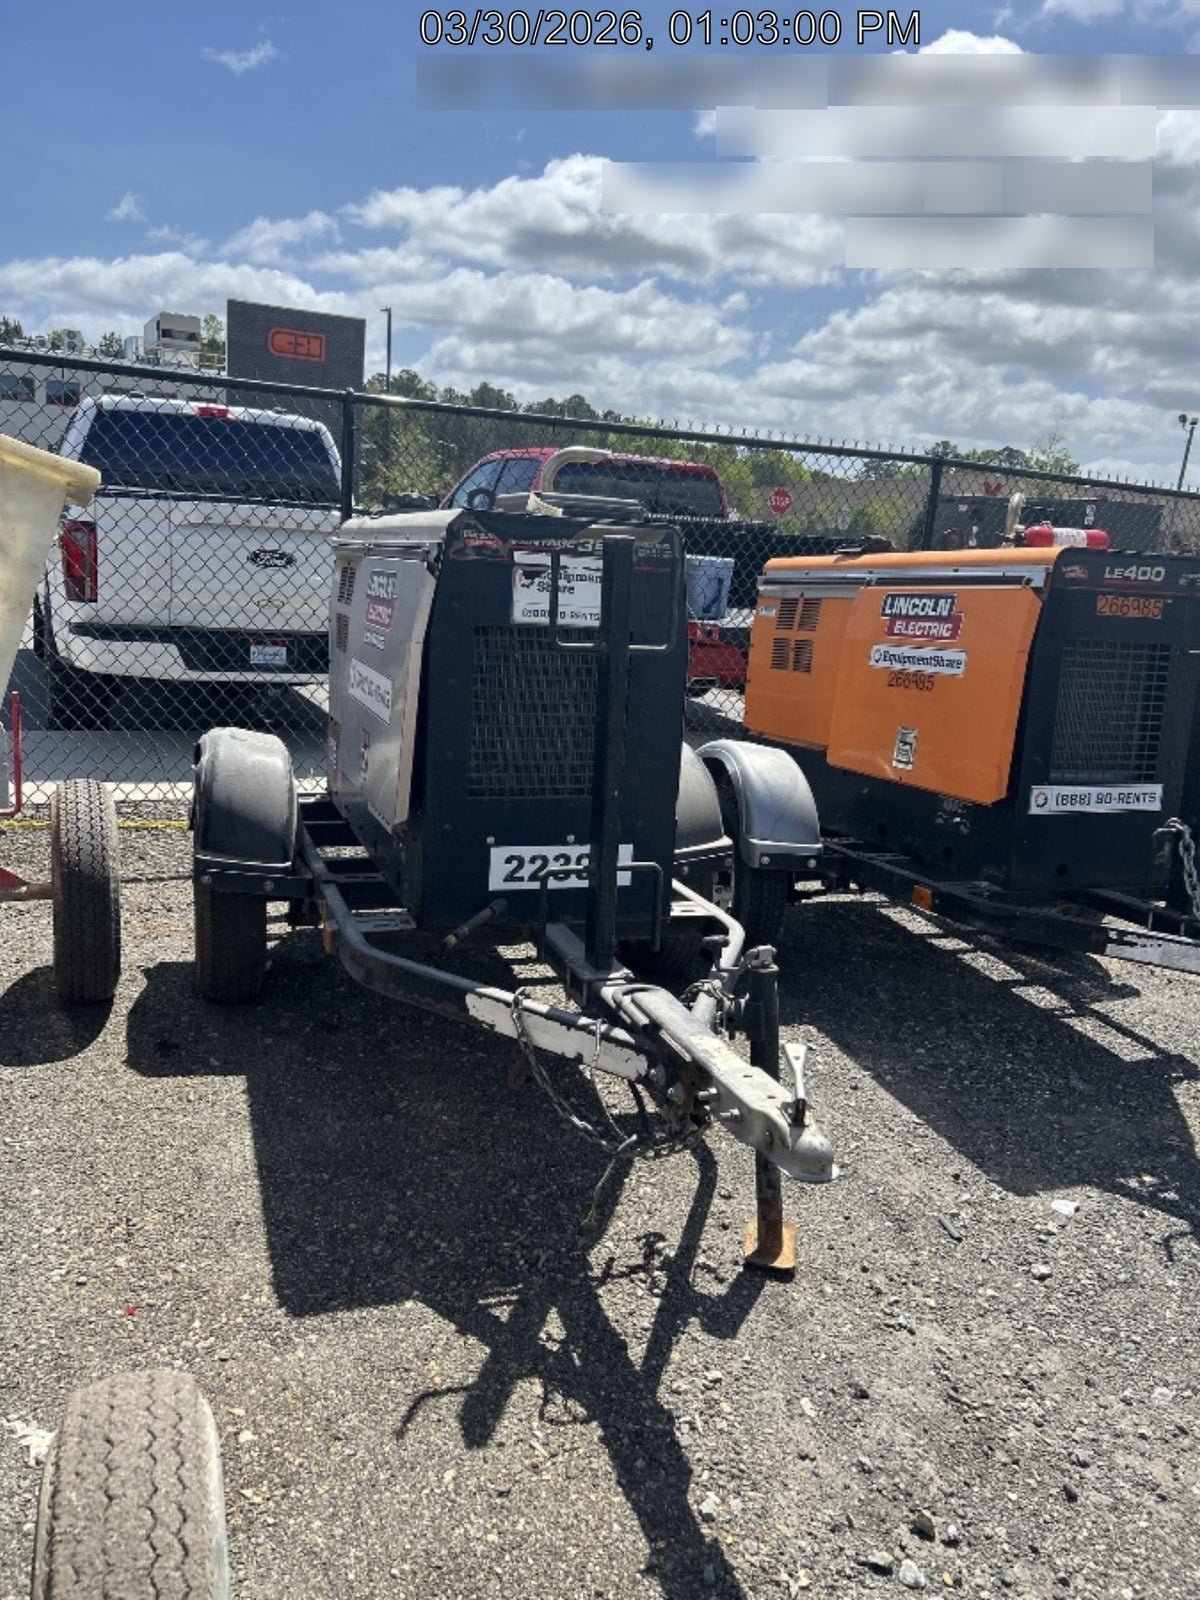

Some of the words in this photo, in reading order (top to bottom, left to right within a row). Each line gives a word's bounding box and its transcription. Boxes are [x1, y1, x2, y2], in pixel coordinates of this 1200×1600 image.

[1104, 564, 1165, 582] LE400
[884, 597, 952, 616] LINCOLN
[1098, 596, 1162, 618] 266985
[893, 621, 953, 637] ELECTRIC
[882, 650, 962, 669] EquipmentShare
[1055, 793, 1092, 806] (888)
